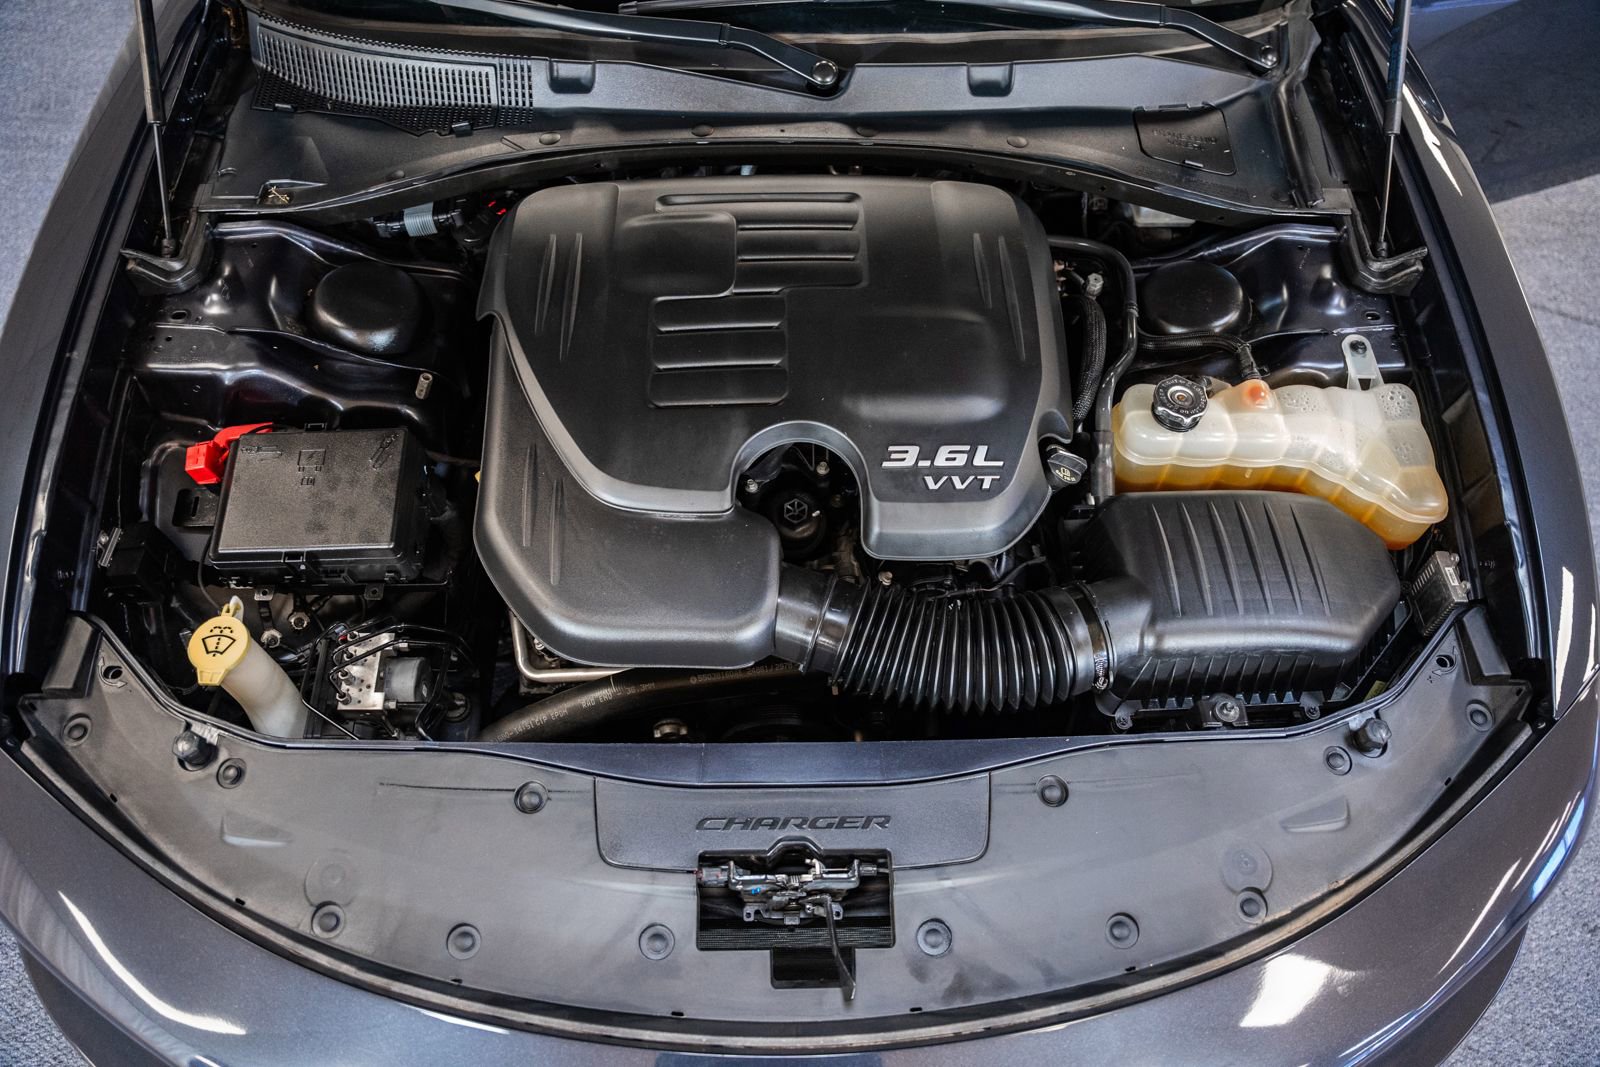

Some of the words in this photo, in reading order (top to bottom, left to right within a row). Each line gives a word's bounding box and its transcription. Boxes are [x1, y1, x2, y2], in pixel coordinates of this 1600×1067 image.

[881, 445, 1004, 467] 3.6L
[923, 475, 1001, 490] VVT
[695, 815, 892, 831] CHARGER
